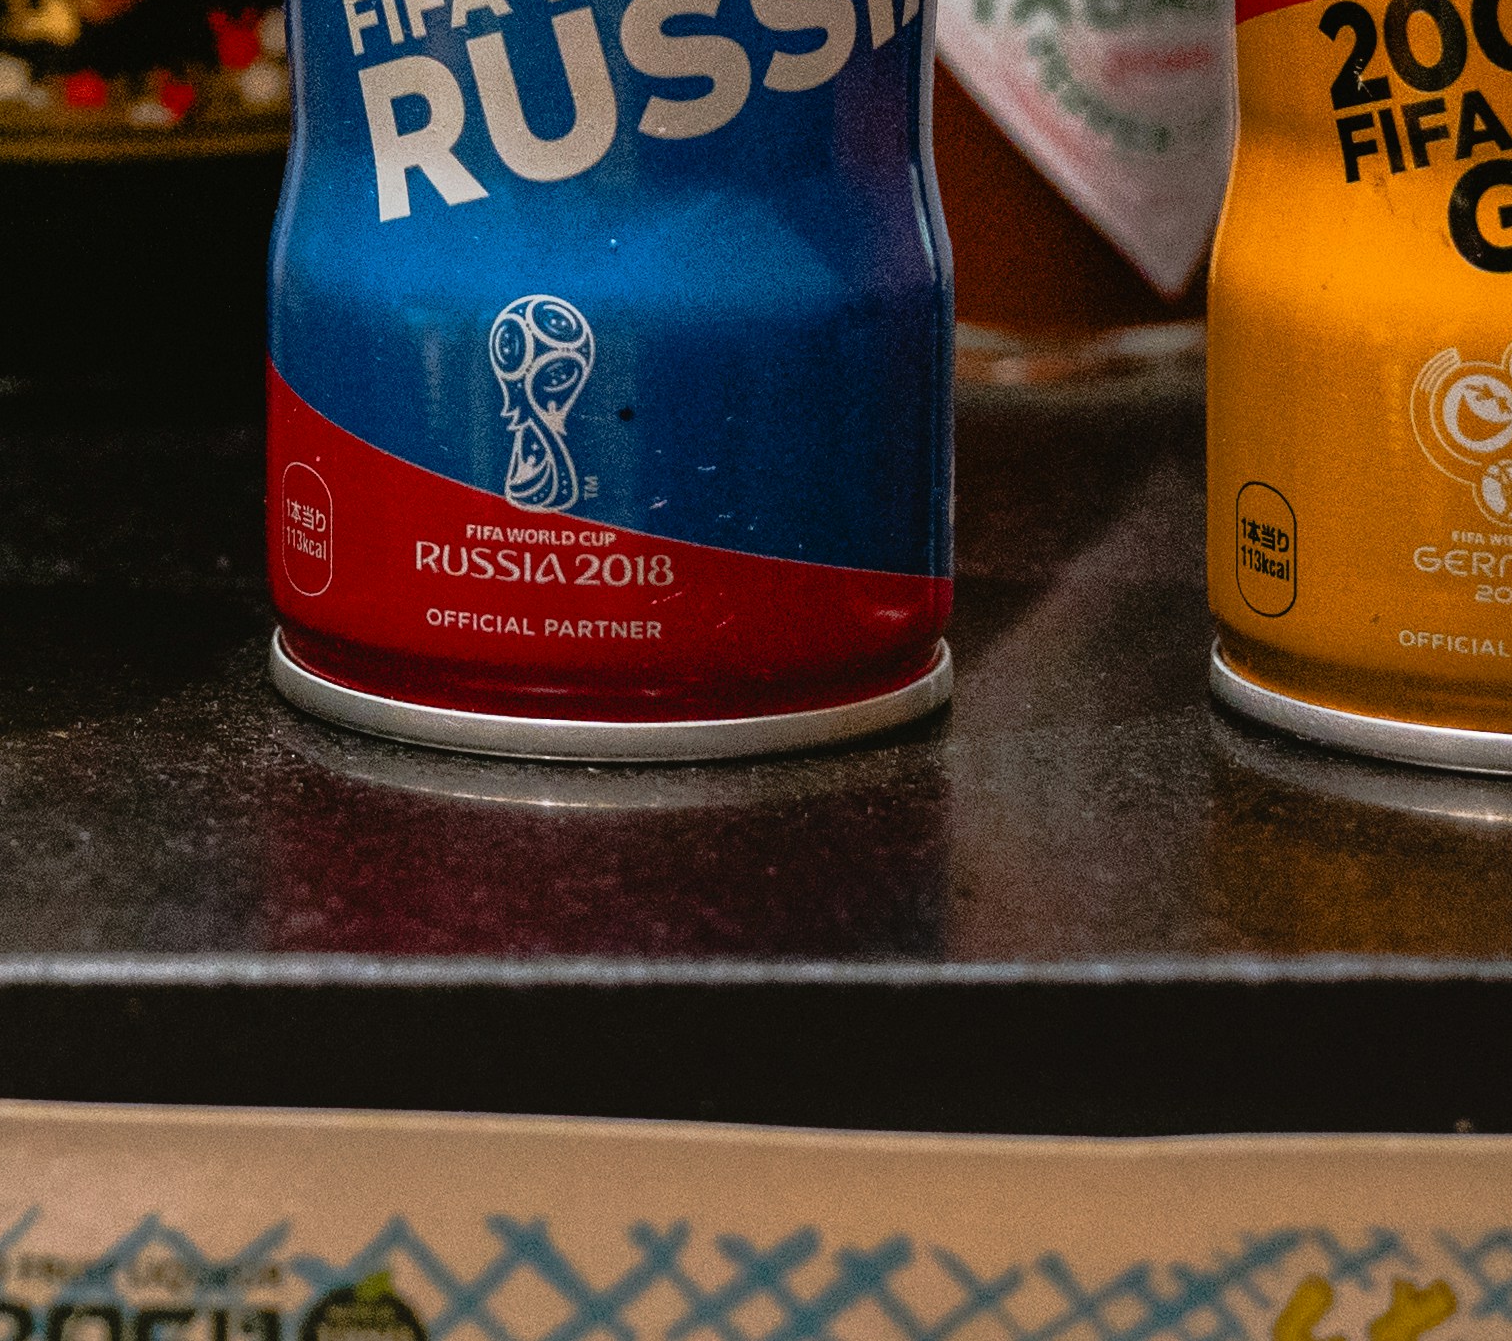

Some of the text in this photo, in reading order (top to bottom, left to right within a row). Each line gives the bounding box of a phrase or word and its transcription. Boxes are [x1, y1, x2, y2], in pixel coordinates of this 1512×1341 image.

[284, 497, 327, 535] 1本当り
[285, 526, 328, 564] 113kcal
[465, 523, 618, 548] FIFA WORLD CUP
[1240, 517, 1291, 554] 1本当り
[414, 540, 675, 588] RUSSIA 2018
[1240, 545, 1291, 582] 113kcal
[425, 607, 663, 640] OFFICIAL PARTNER
[1398, 629, 1511, 659] OFFICIAL
